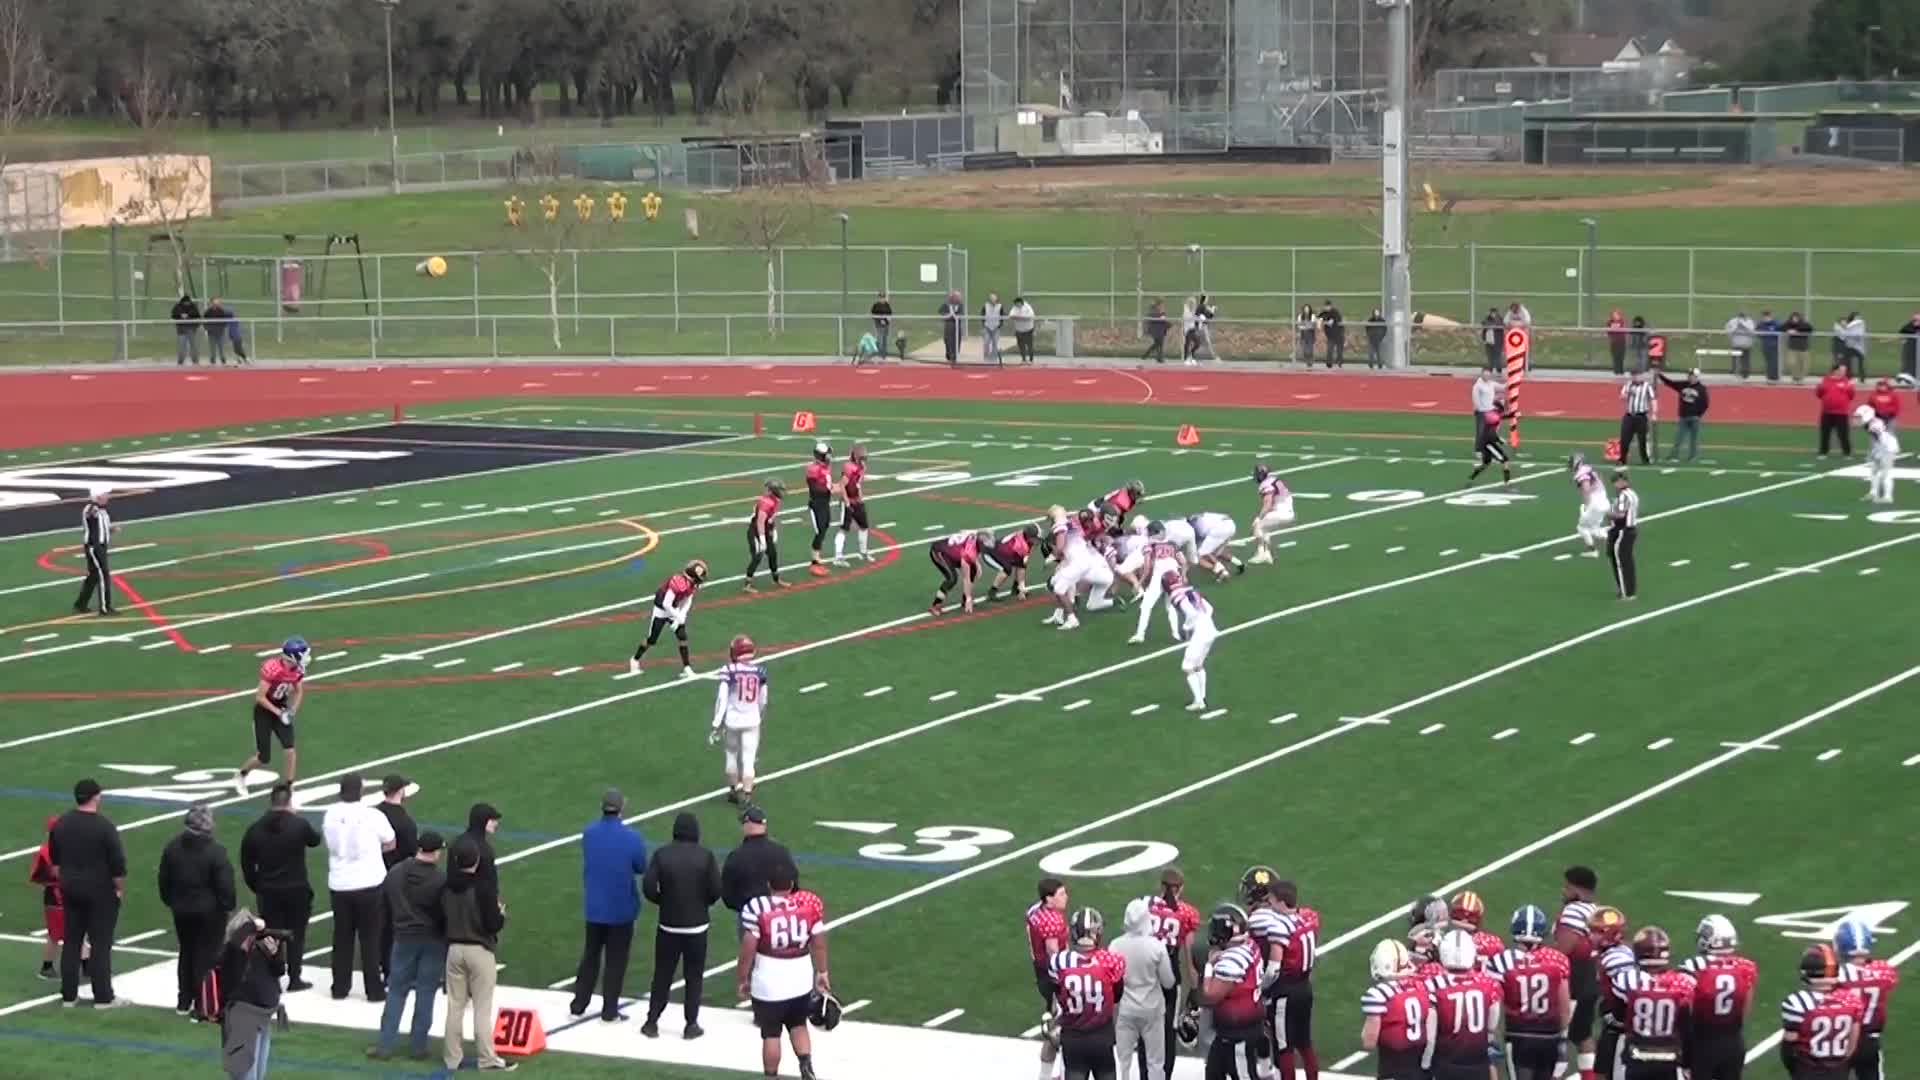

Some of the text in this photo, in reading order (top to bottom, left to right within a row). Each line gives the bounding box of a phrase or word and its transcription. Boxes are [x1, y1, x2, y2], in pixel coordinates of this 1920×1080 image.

[735, 673, 760, 704] 19
[770, 914, 810, 949] 64
[1300, 930, 1316, 972] 11
[1064, 974, 1105, 1014] 34
[1447, 989, 1486, 1034] 70
[1516, 972, 1550, 1014] 12
[1714, 974, 1736, 1015] 2
[494, 1009, 533, 1048] 30
[1404, 996, 1422, 1042] 9
[1632, 997, 1676, 1037] 80
[1809, 1014, 1854, 1058] 22
